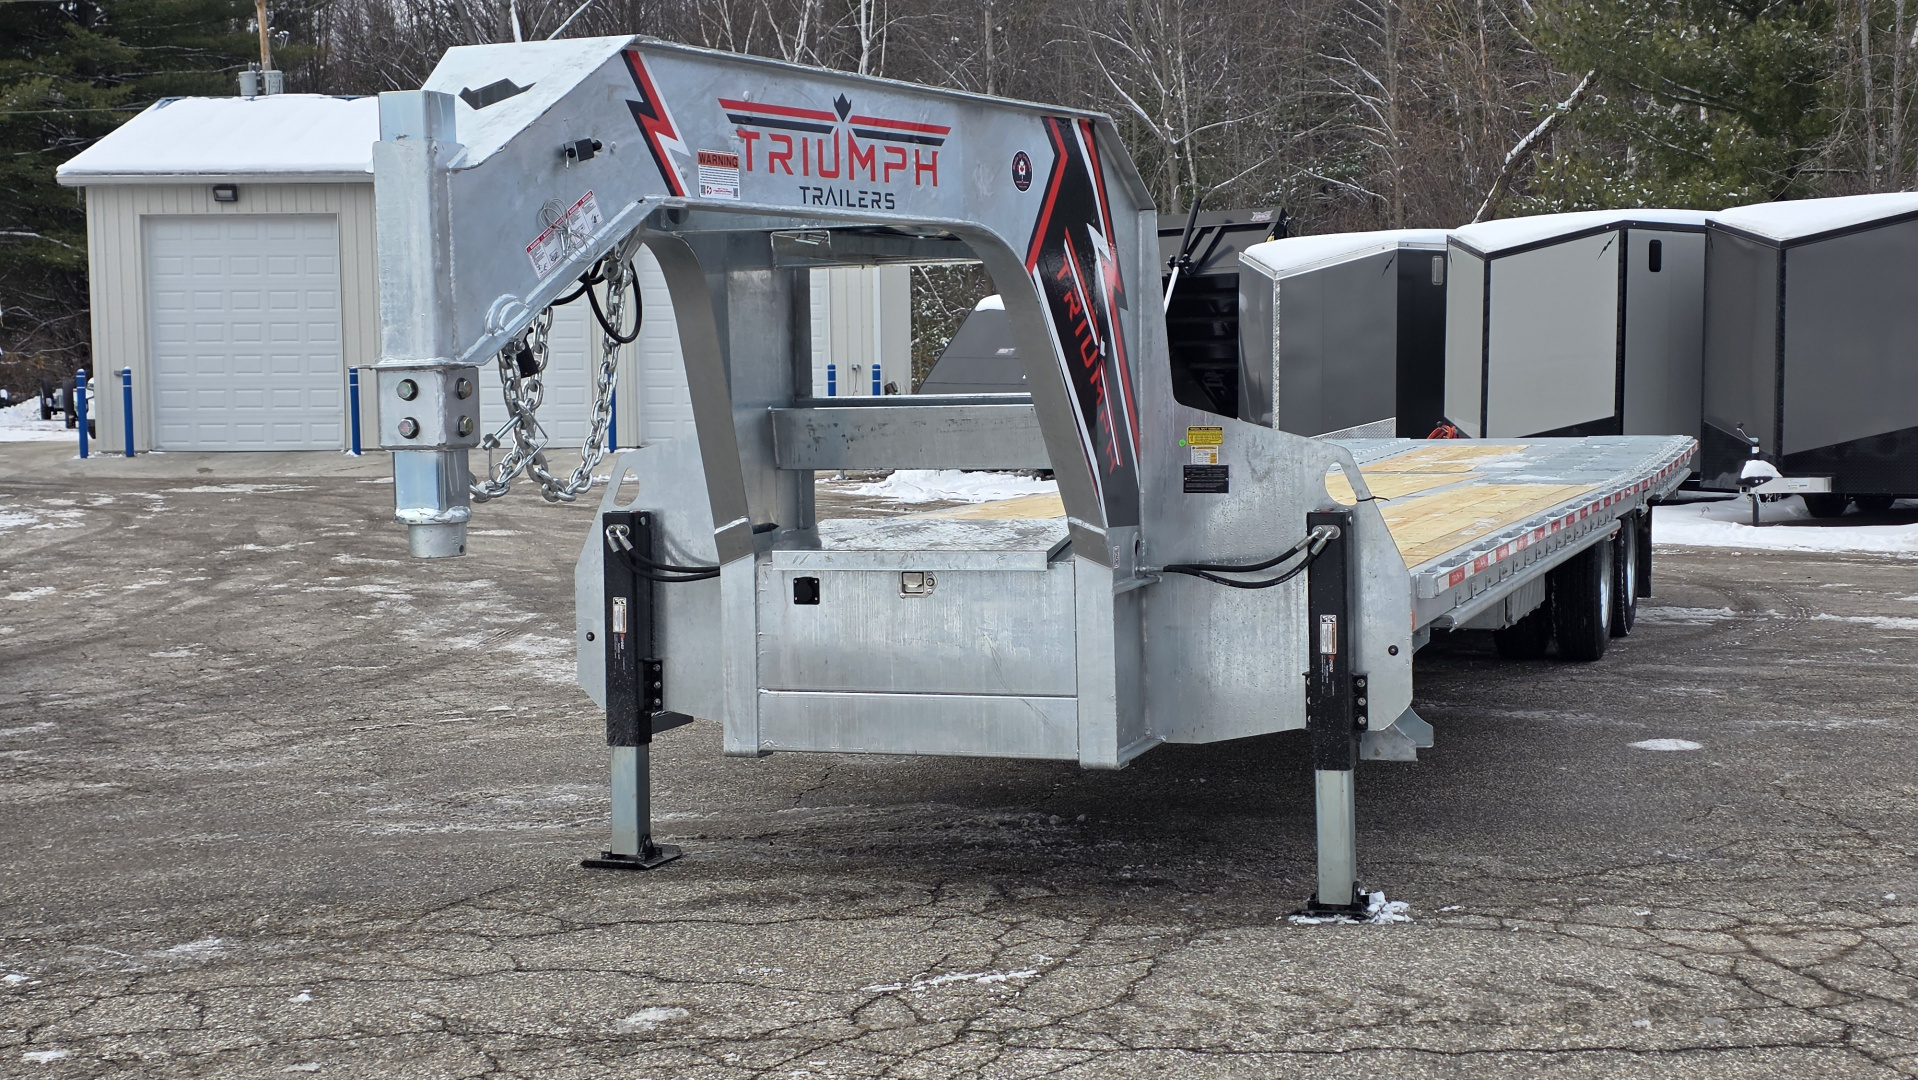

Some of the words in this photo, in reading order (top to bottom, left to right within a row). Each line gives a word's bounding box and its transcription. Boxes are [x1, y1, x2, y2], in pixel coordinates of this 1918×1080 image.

[698, 152, 739, 168] WARNING
[735, 128, 939, 187] TRIUMPH
[799, 185, 895, 210] TRAILERS
[1056, 252, 1117, 475] TRIUMPH
